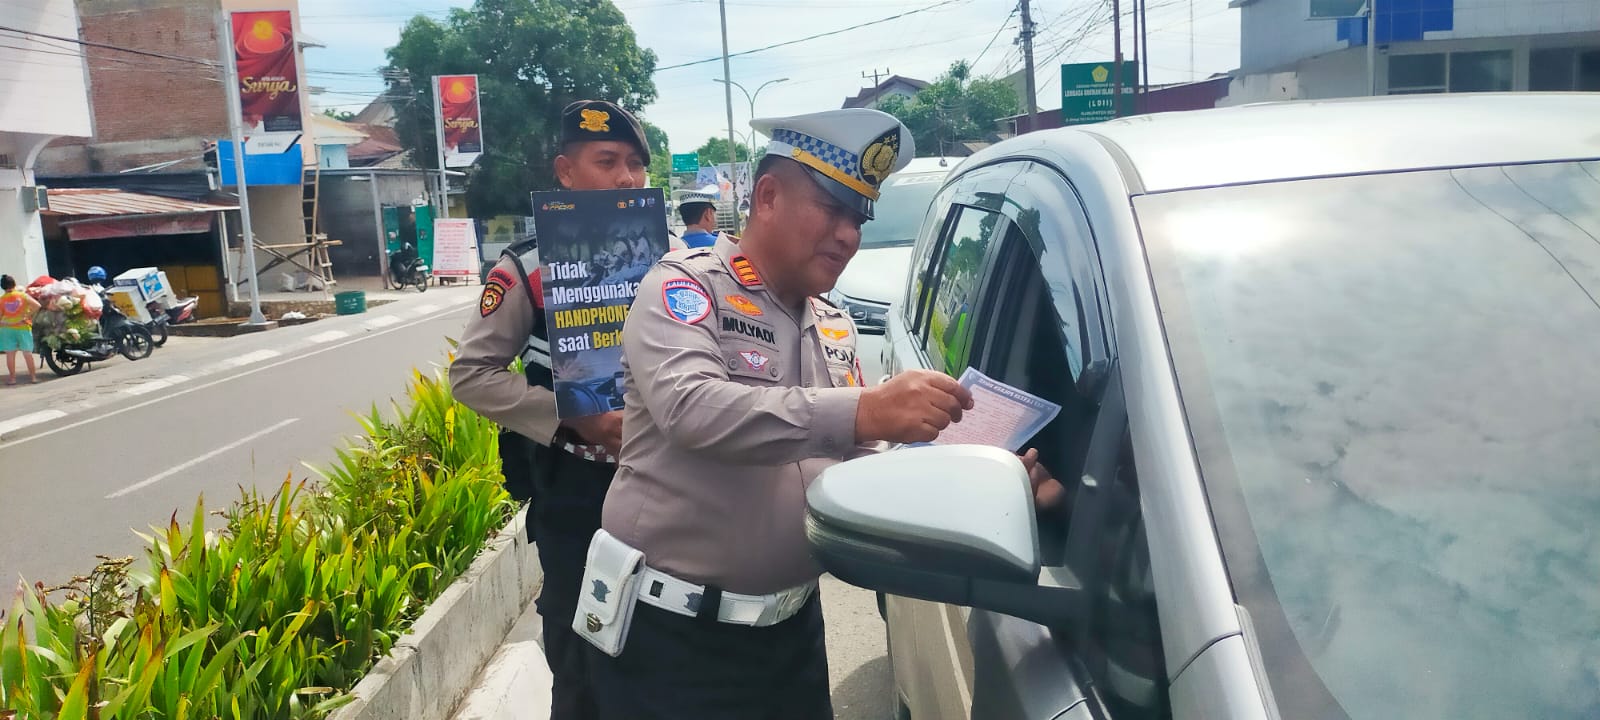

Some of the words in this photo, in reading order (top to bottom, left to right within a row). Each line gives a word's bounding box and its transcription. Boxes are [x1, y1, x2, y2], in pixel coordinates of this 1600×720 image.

[241, 77, 296, 100] Surya
[548, 260, 588, 281] Tidak
[552, 281, 640, 305] Menggunaka
[558, 333, 590, 353] saat
[592, 329, 624, 349] Berk
[722, 316, 776, 345] MULYADI
